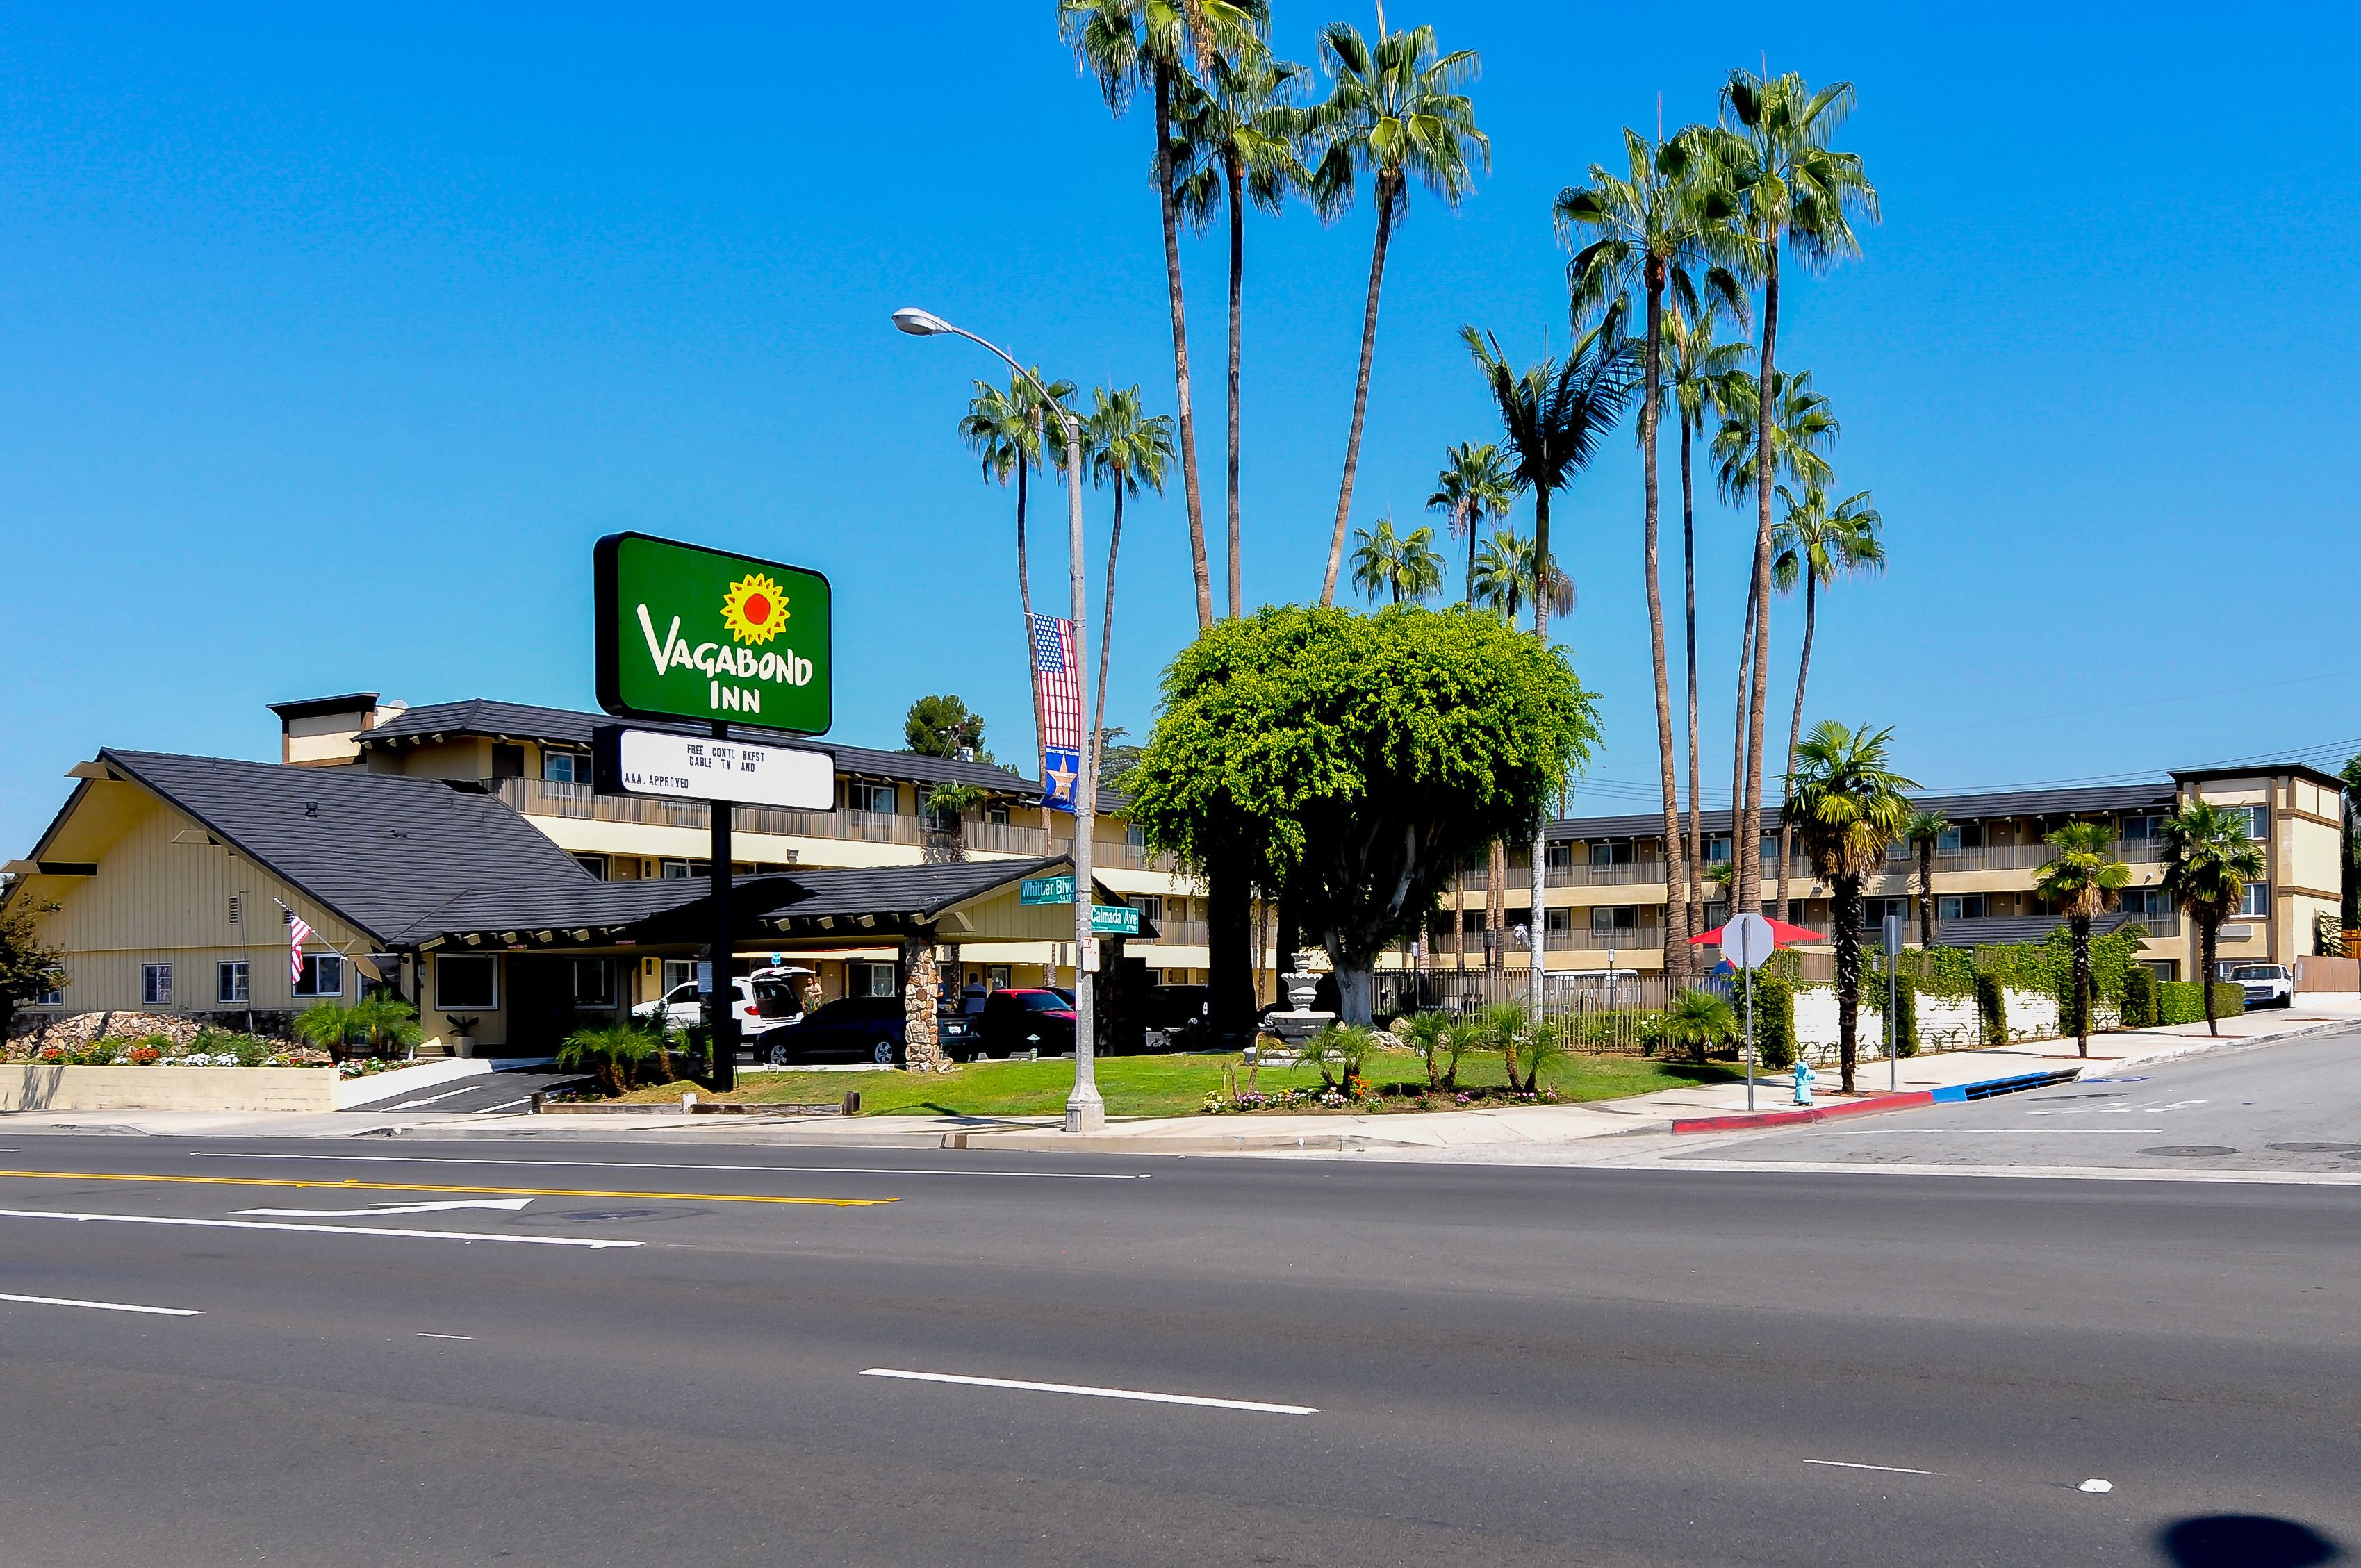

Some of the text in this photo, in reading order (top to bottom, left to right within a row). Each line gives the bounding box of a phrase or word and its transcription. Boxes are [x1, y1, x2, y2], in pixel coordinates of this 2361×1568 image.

[637, 603, 814, 686] VAGABOND
[711, 680, 761, 713] INN
[687, 744, 704, 755] FREE
[743, 751, 765, 762] BKFST
[689, 756, 755, 772] CABLE TV AND
[1022, 878, 1074, 897] Whittier Blvd
[1091, 907, 1137, 925] Calmada Ave
